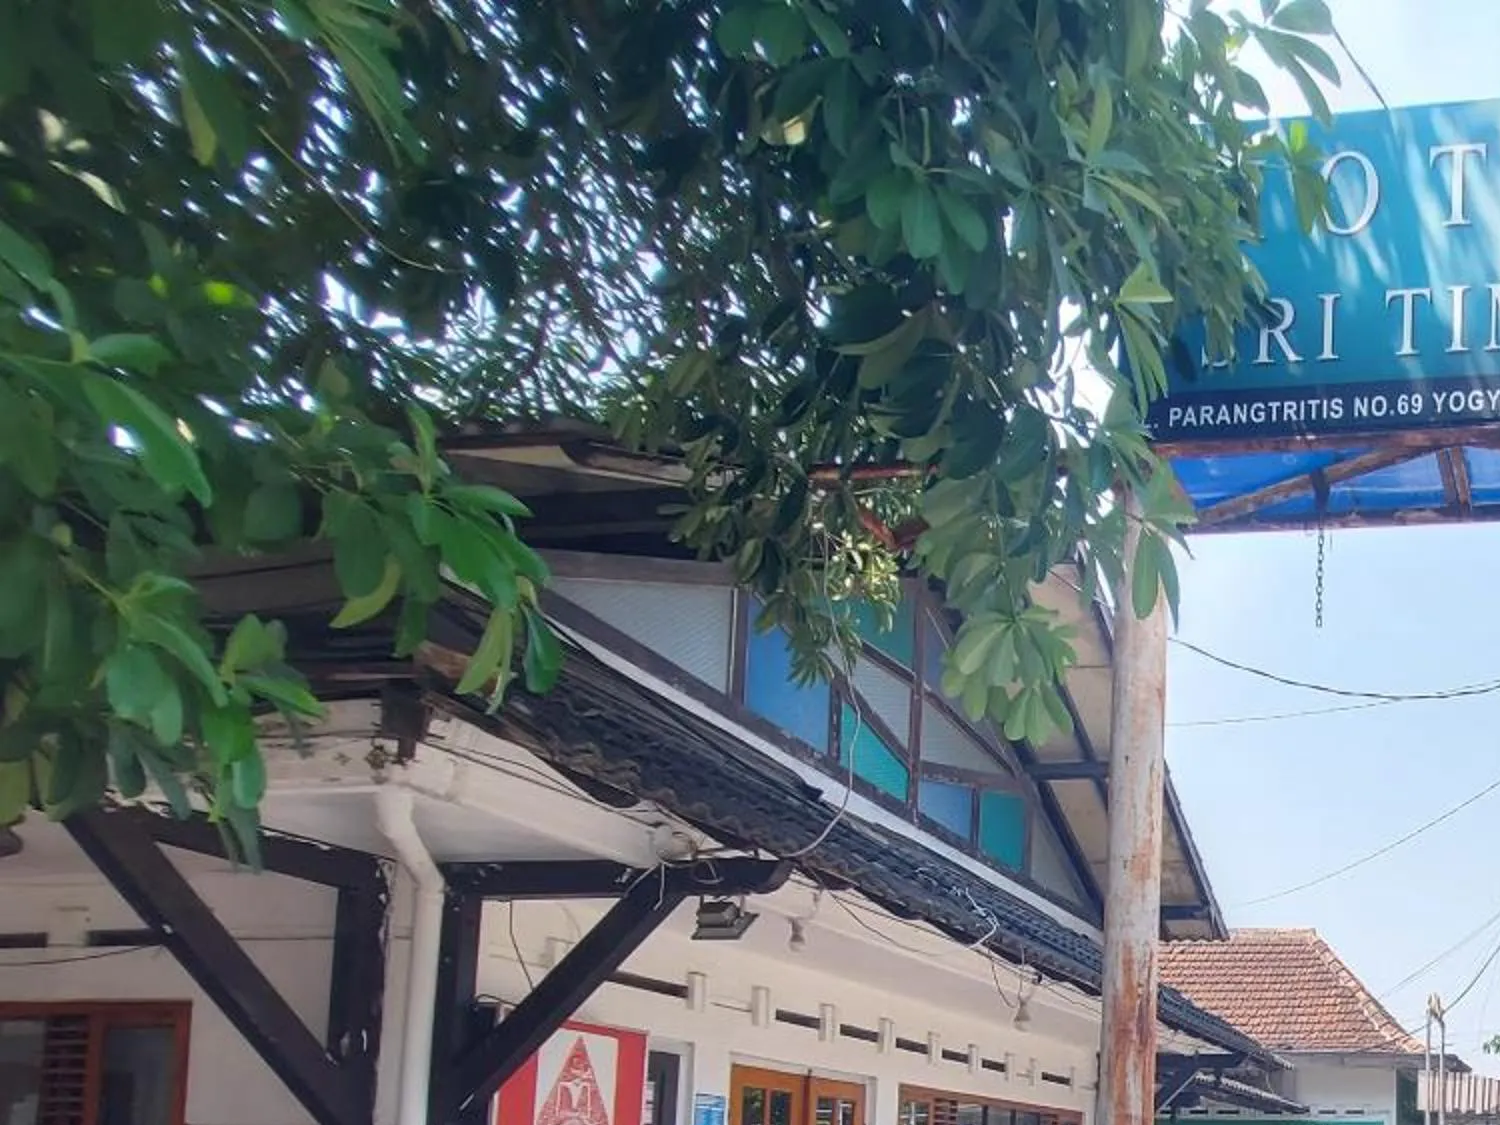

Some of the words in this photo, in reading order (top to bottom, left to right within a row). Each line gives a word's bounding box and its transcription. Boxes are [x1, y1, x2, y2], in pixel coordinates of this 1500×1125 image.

[1201, 291, 1342, 369] RI
[1168, 398, 1345, 428] PARANGTRITIS
[1353, 393, 1424, 417] NO.69
